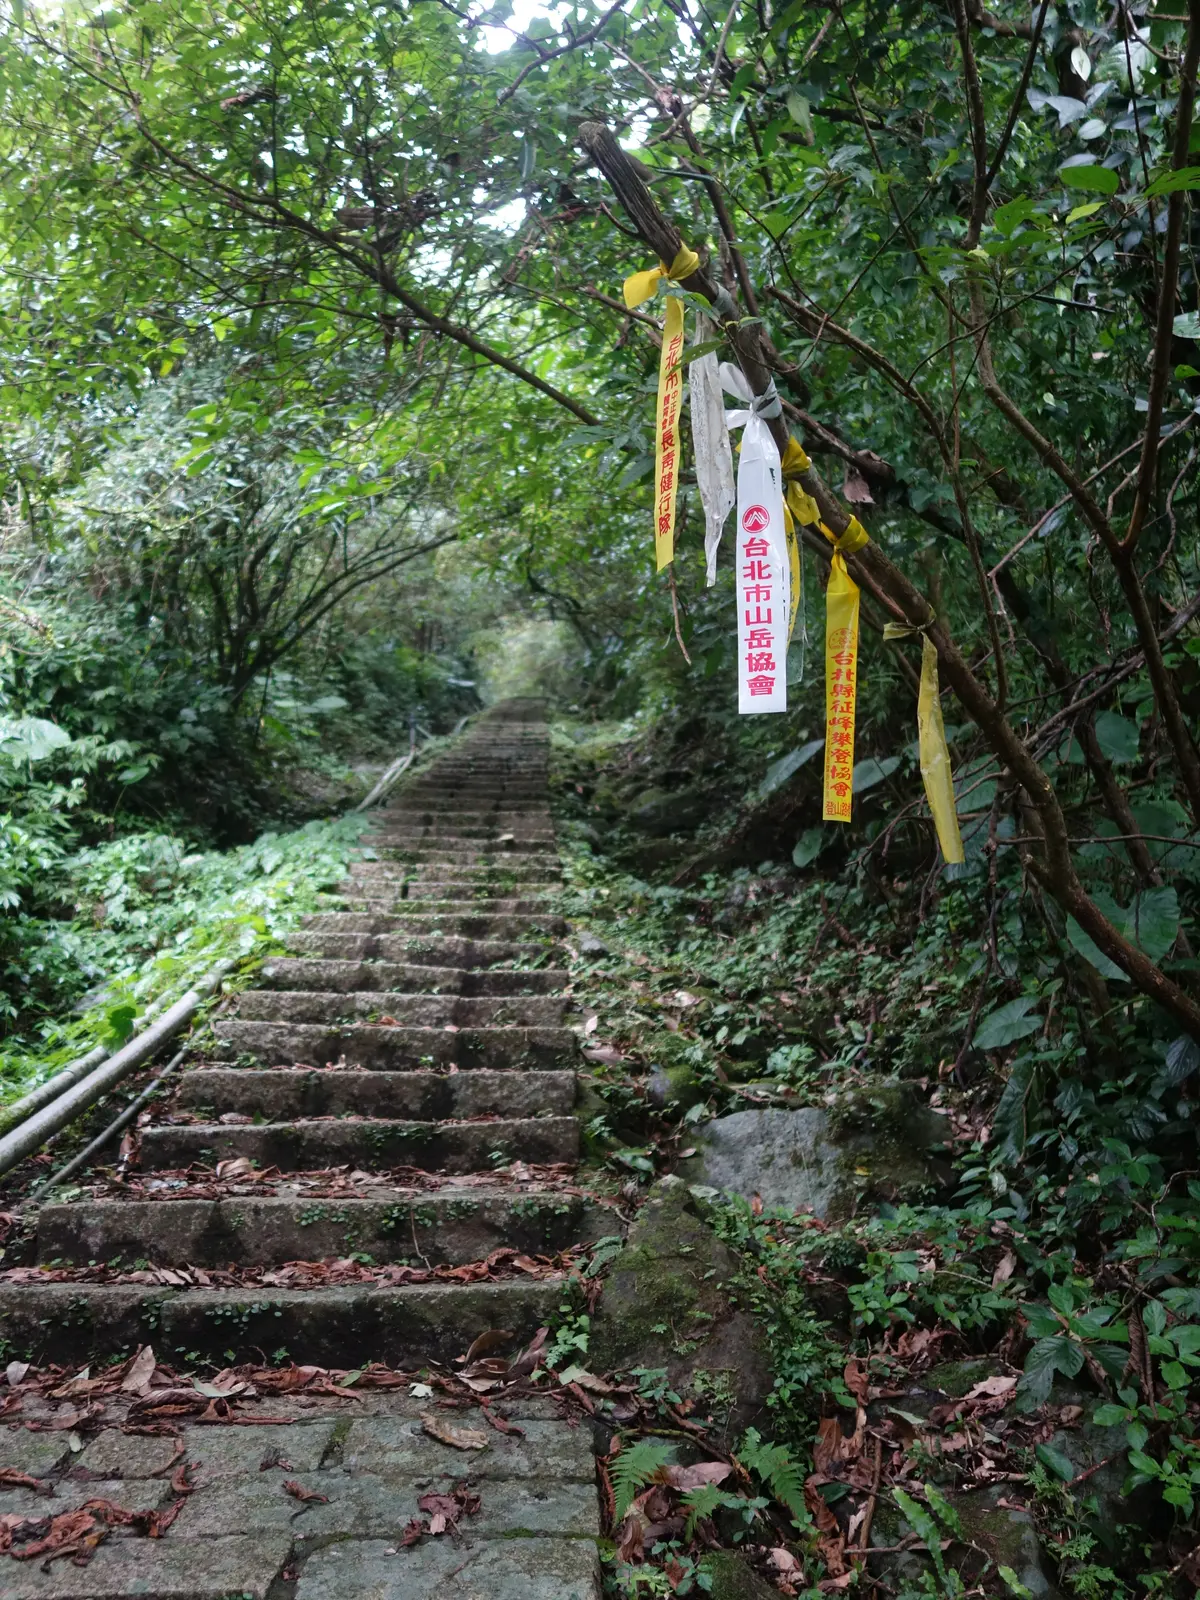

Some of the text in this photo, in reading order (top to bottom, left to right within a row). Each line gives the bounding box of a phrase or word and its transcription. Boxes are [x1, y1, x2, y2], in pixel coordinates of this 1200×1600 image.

[742, 537, 776, 696] 台北市山岳協會
